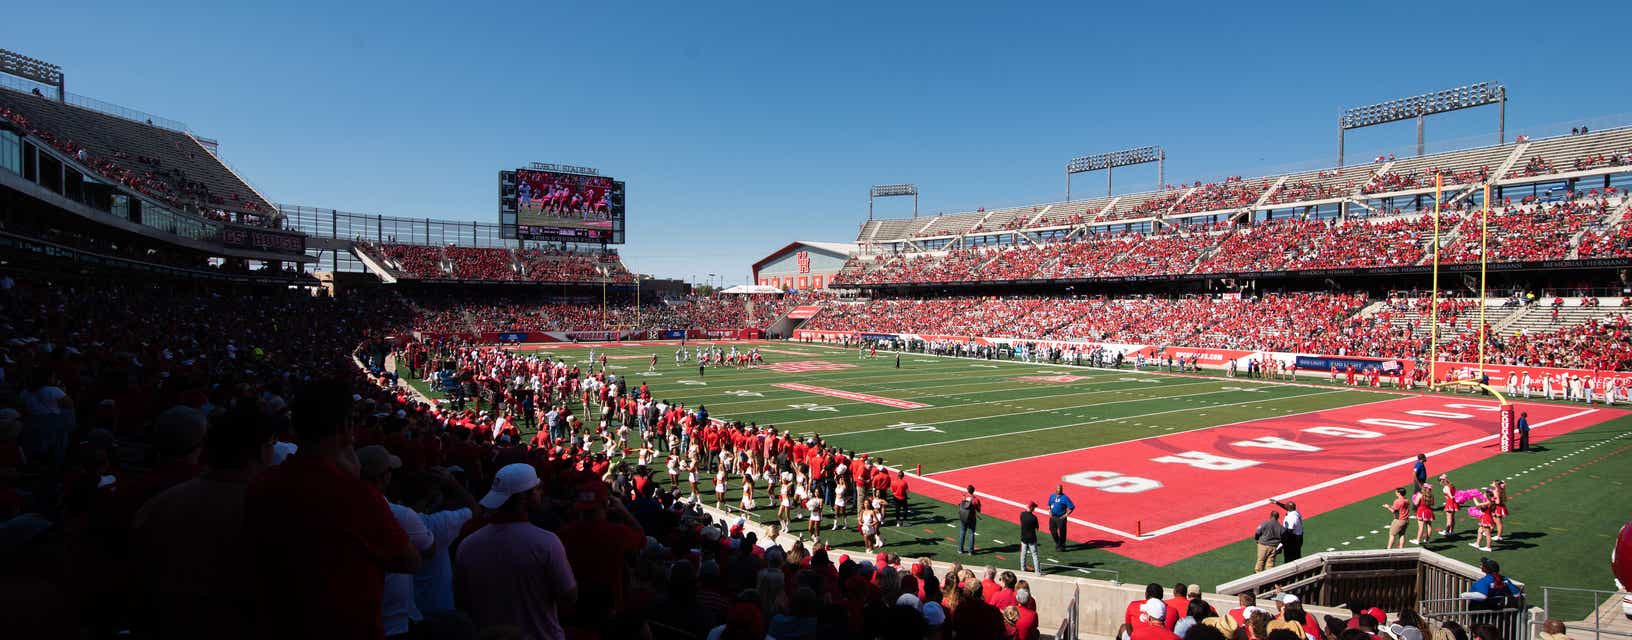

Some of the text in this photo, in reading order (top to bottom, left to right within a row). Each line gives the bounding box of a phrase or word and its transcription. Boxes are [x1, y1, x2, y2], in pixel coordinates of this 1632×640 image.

[534, 162, 598, 174] TDECU STADIUM
[1061, 402, 1501, 494] COUGARS
[1501, 411, 1510, 452] COUGARS
